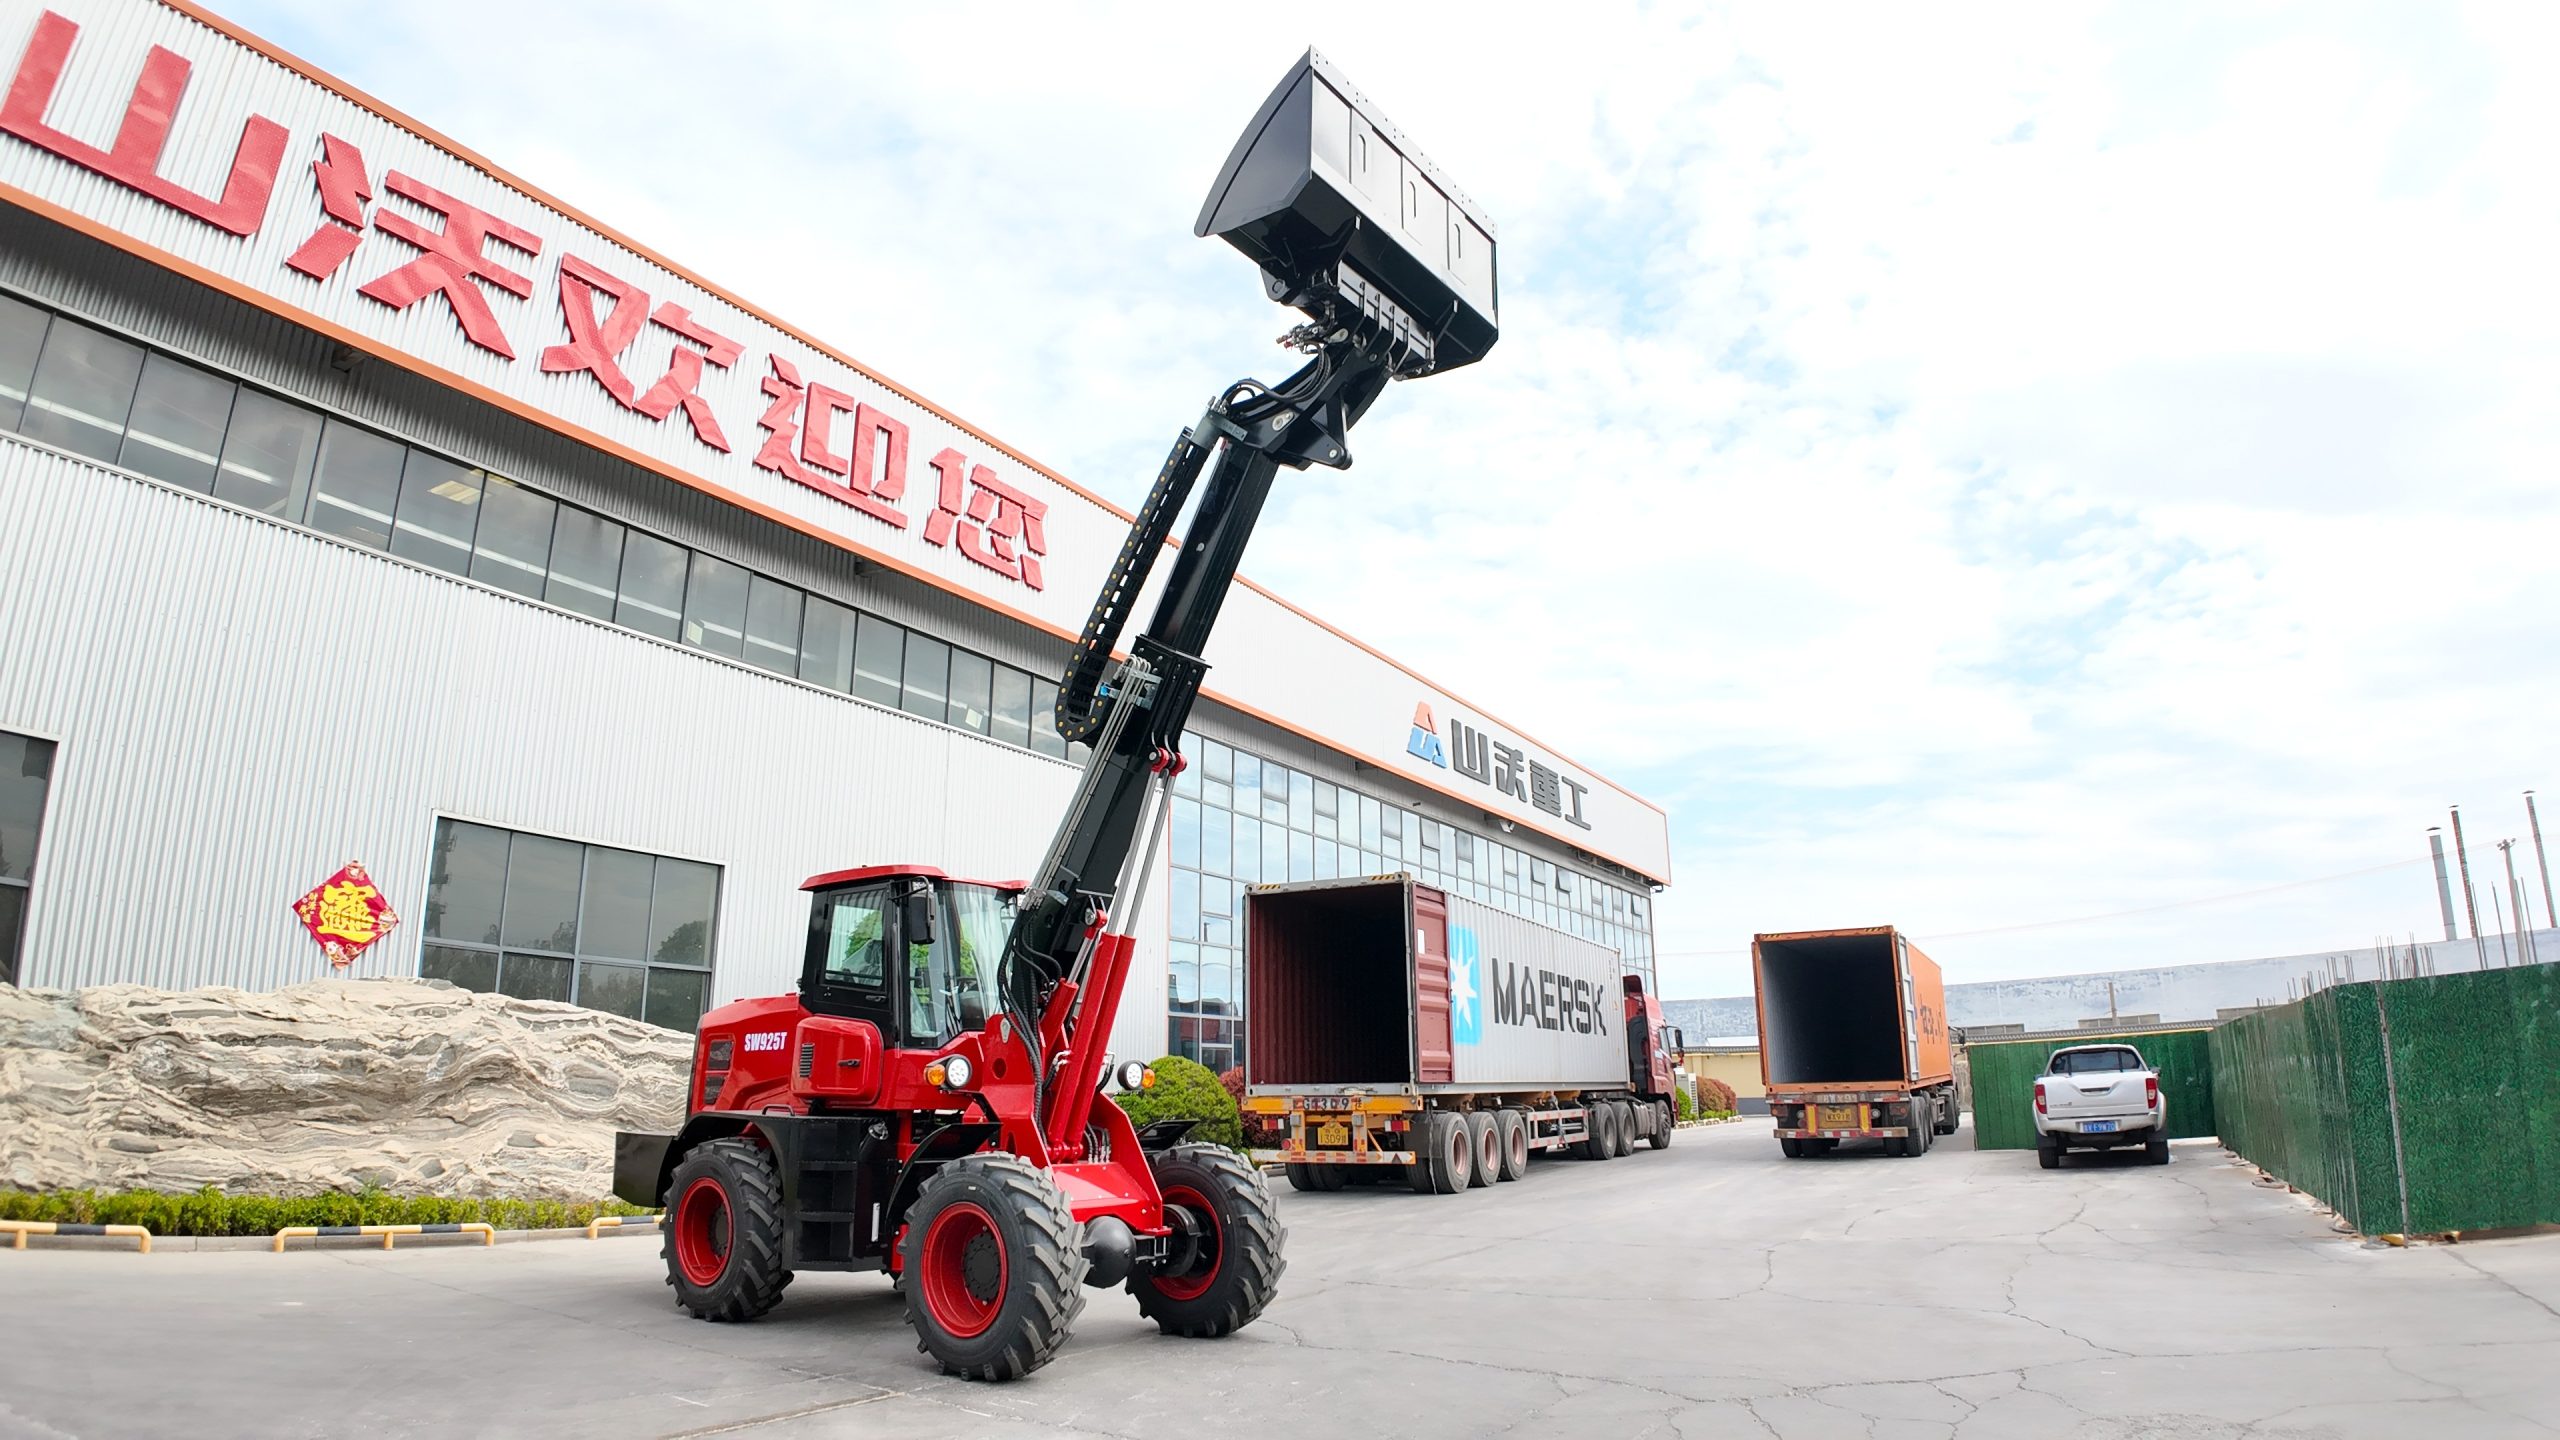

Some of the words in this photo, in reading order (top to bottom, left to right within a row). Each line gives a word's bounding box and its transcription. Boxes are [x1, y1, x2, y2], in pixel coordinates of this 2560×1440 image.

[0, 9, 1048, 591] 山沃欢迎您
[1451, 718, 1592, 831] 山沃重工
[744, 1031, 788, 1052] SW925T
[1491, 957, 1607, 1037] MAERSK
